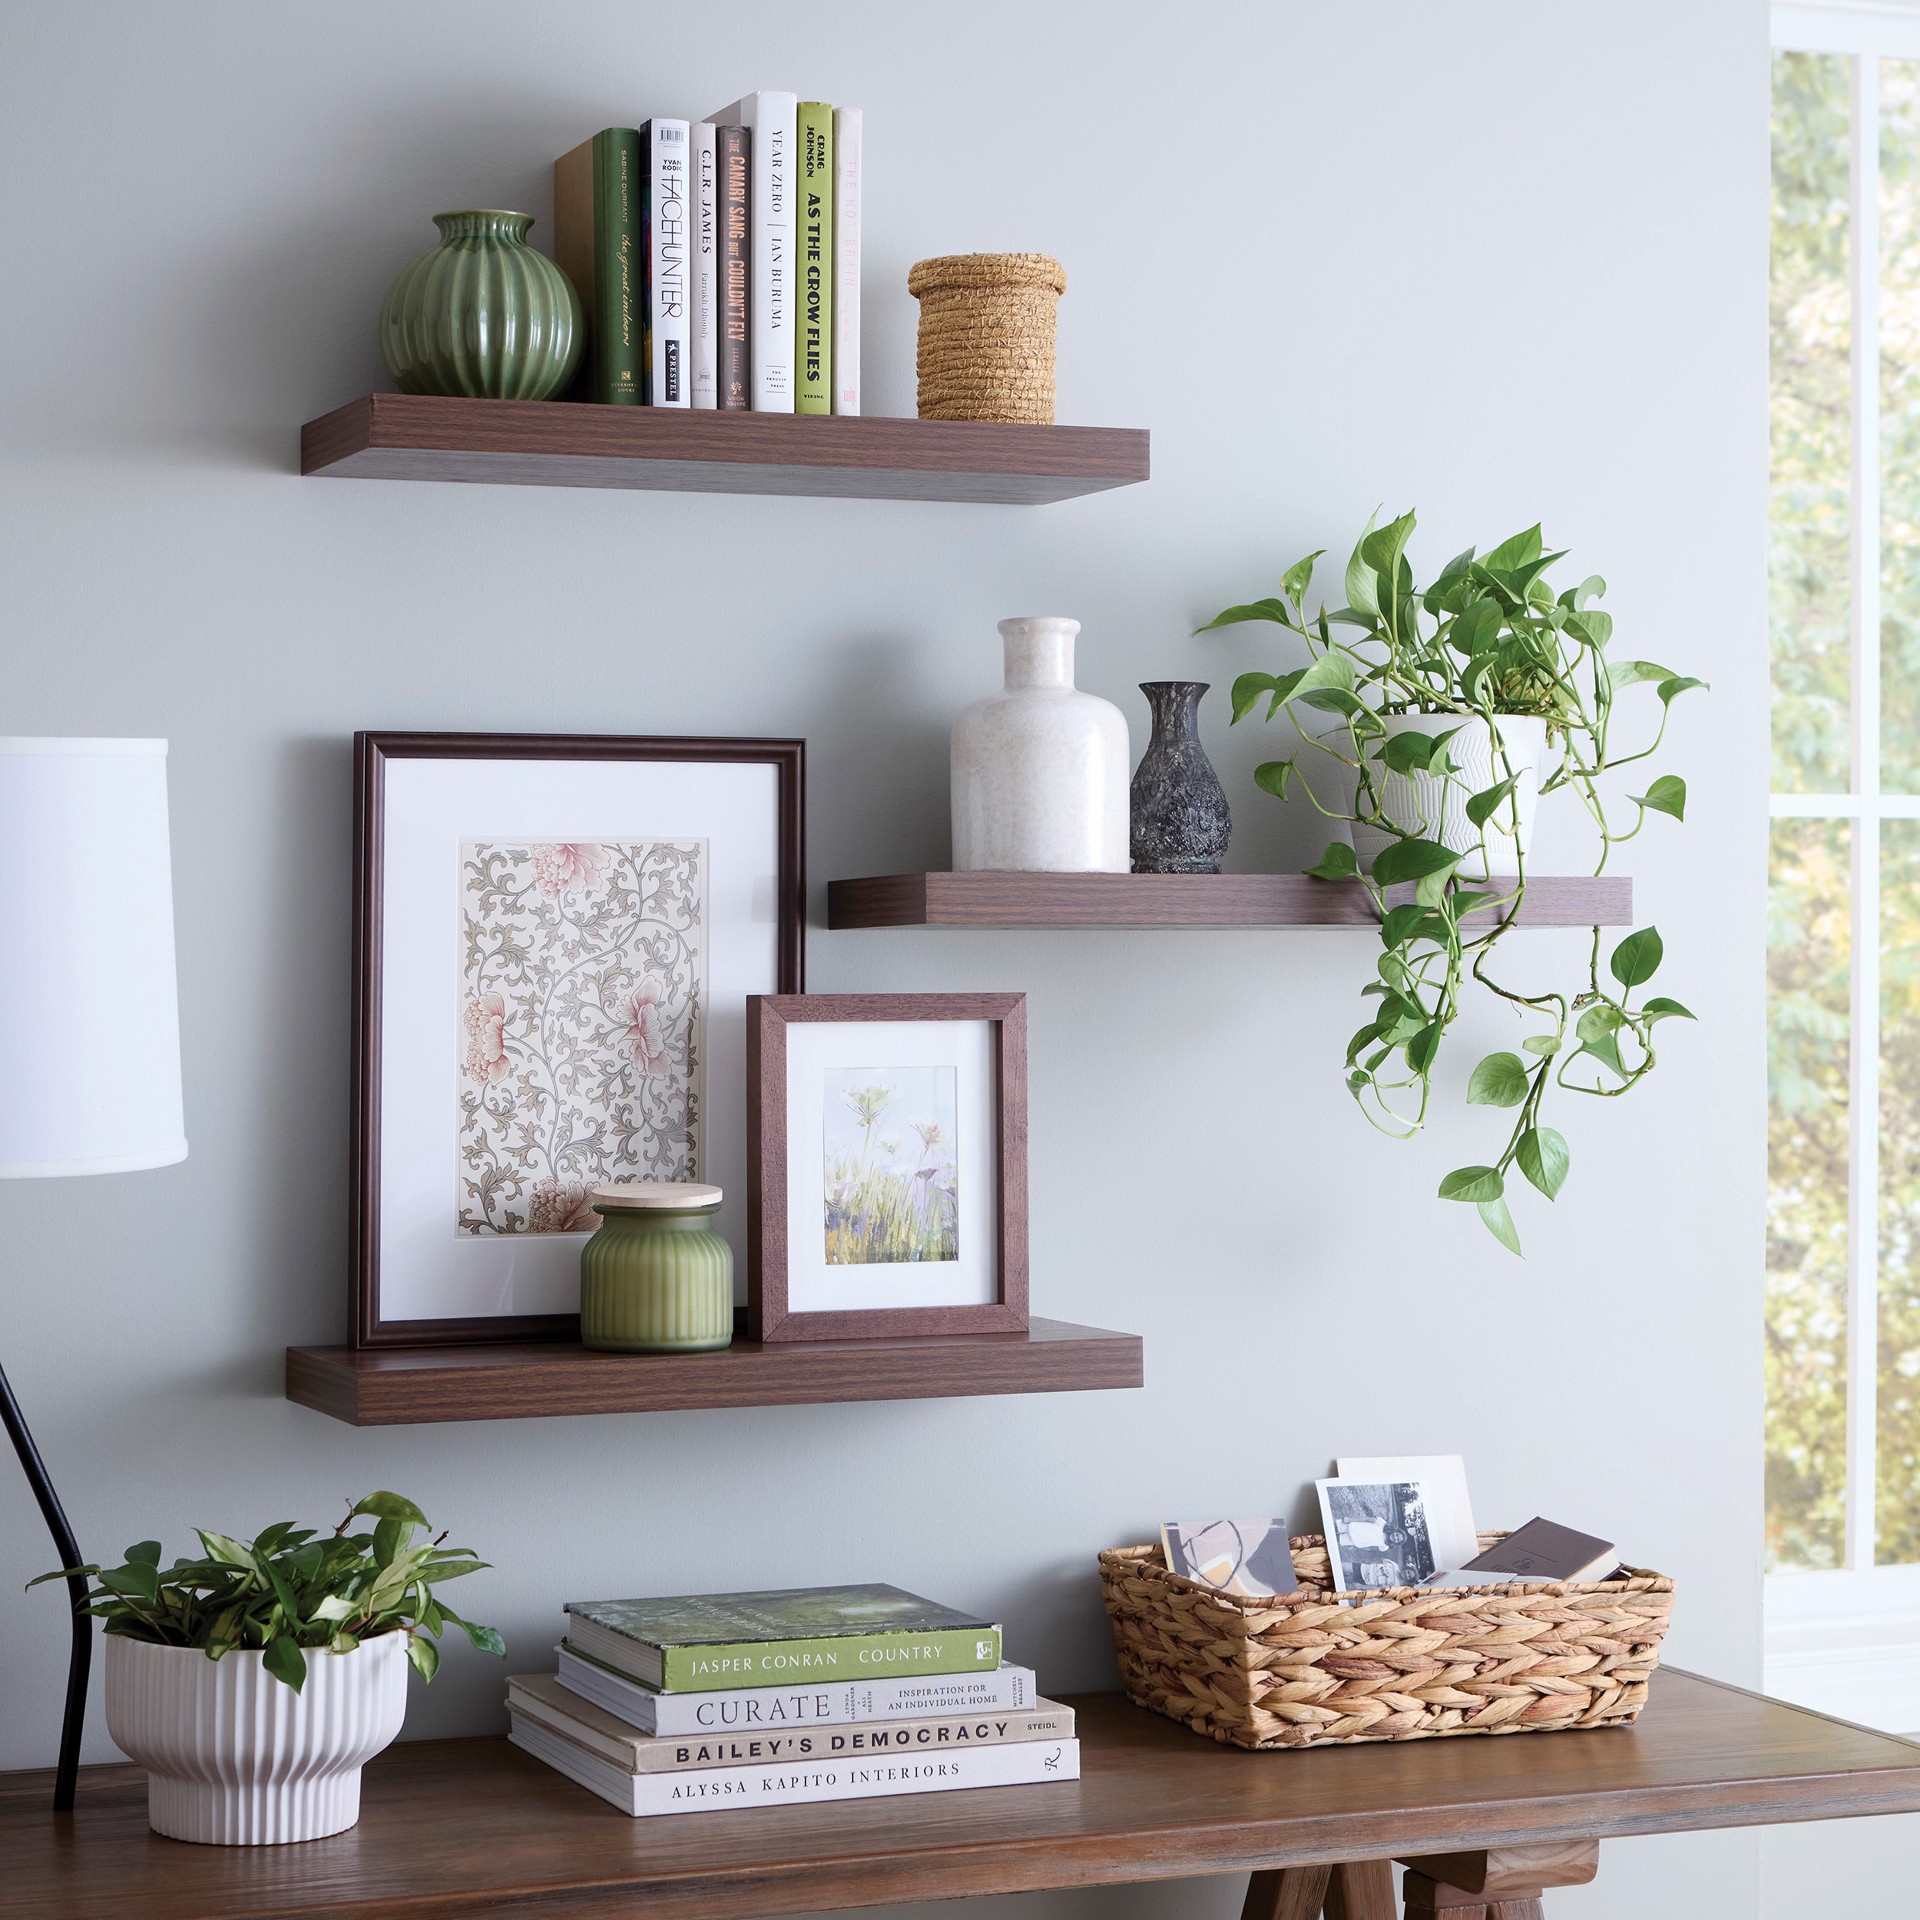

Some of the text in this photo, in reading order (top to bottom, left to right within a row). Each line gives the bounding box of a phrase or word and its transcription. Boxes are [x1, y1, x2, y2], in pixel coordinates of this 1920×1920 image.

[620, 149, 628, 181] SABINE
[806, 125, 815, 178] JOHNSON
[817, 135, 825, 169] CRAIG
[846, 160, 856, 188] THE
[702, 149, 712, 254] C.L.R. JAMES
[621, 234, 632, 252] the
[661, 174, 683, 318] FACEHUNTER
[728, 139, 745, 342] THE CANARY SANG BUT COULDN'T FLY
[771, 130, 782, 330] YEAR ZERO IAN BURUMA
[616, 251, 631, 293] great
[806, 192, 821, 382] AS THE CROW FLIES
[622, 293, 633, 346] indoors
[700, 272, 709, 339] Farrukh Dhondy
[669, 355, 677, 396] PRESTEL
[691, 1645, 943, 1677] JASPER CONRAN COUNTRY
[696, 1694, 831, 1726] CURATE
[888, 1694, 998, 1710] AN INDIVIDUAL HOME
[898, 1684, 987, 1698] INSPIRATION FOR
[676, 1722, 1009, 1763] BAILEY'S DEMOCRACY
[1027, 1722, 1057, 1731] STEIDL
[1044, 1747, 1062, 1772] R
[672, 1763, 960, 1799] ALYSSA KAPITO INTERIORS
